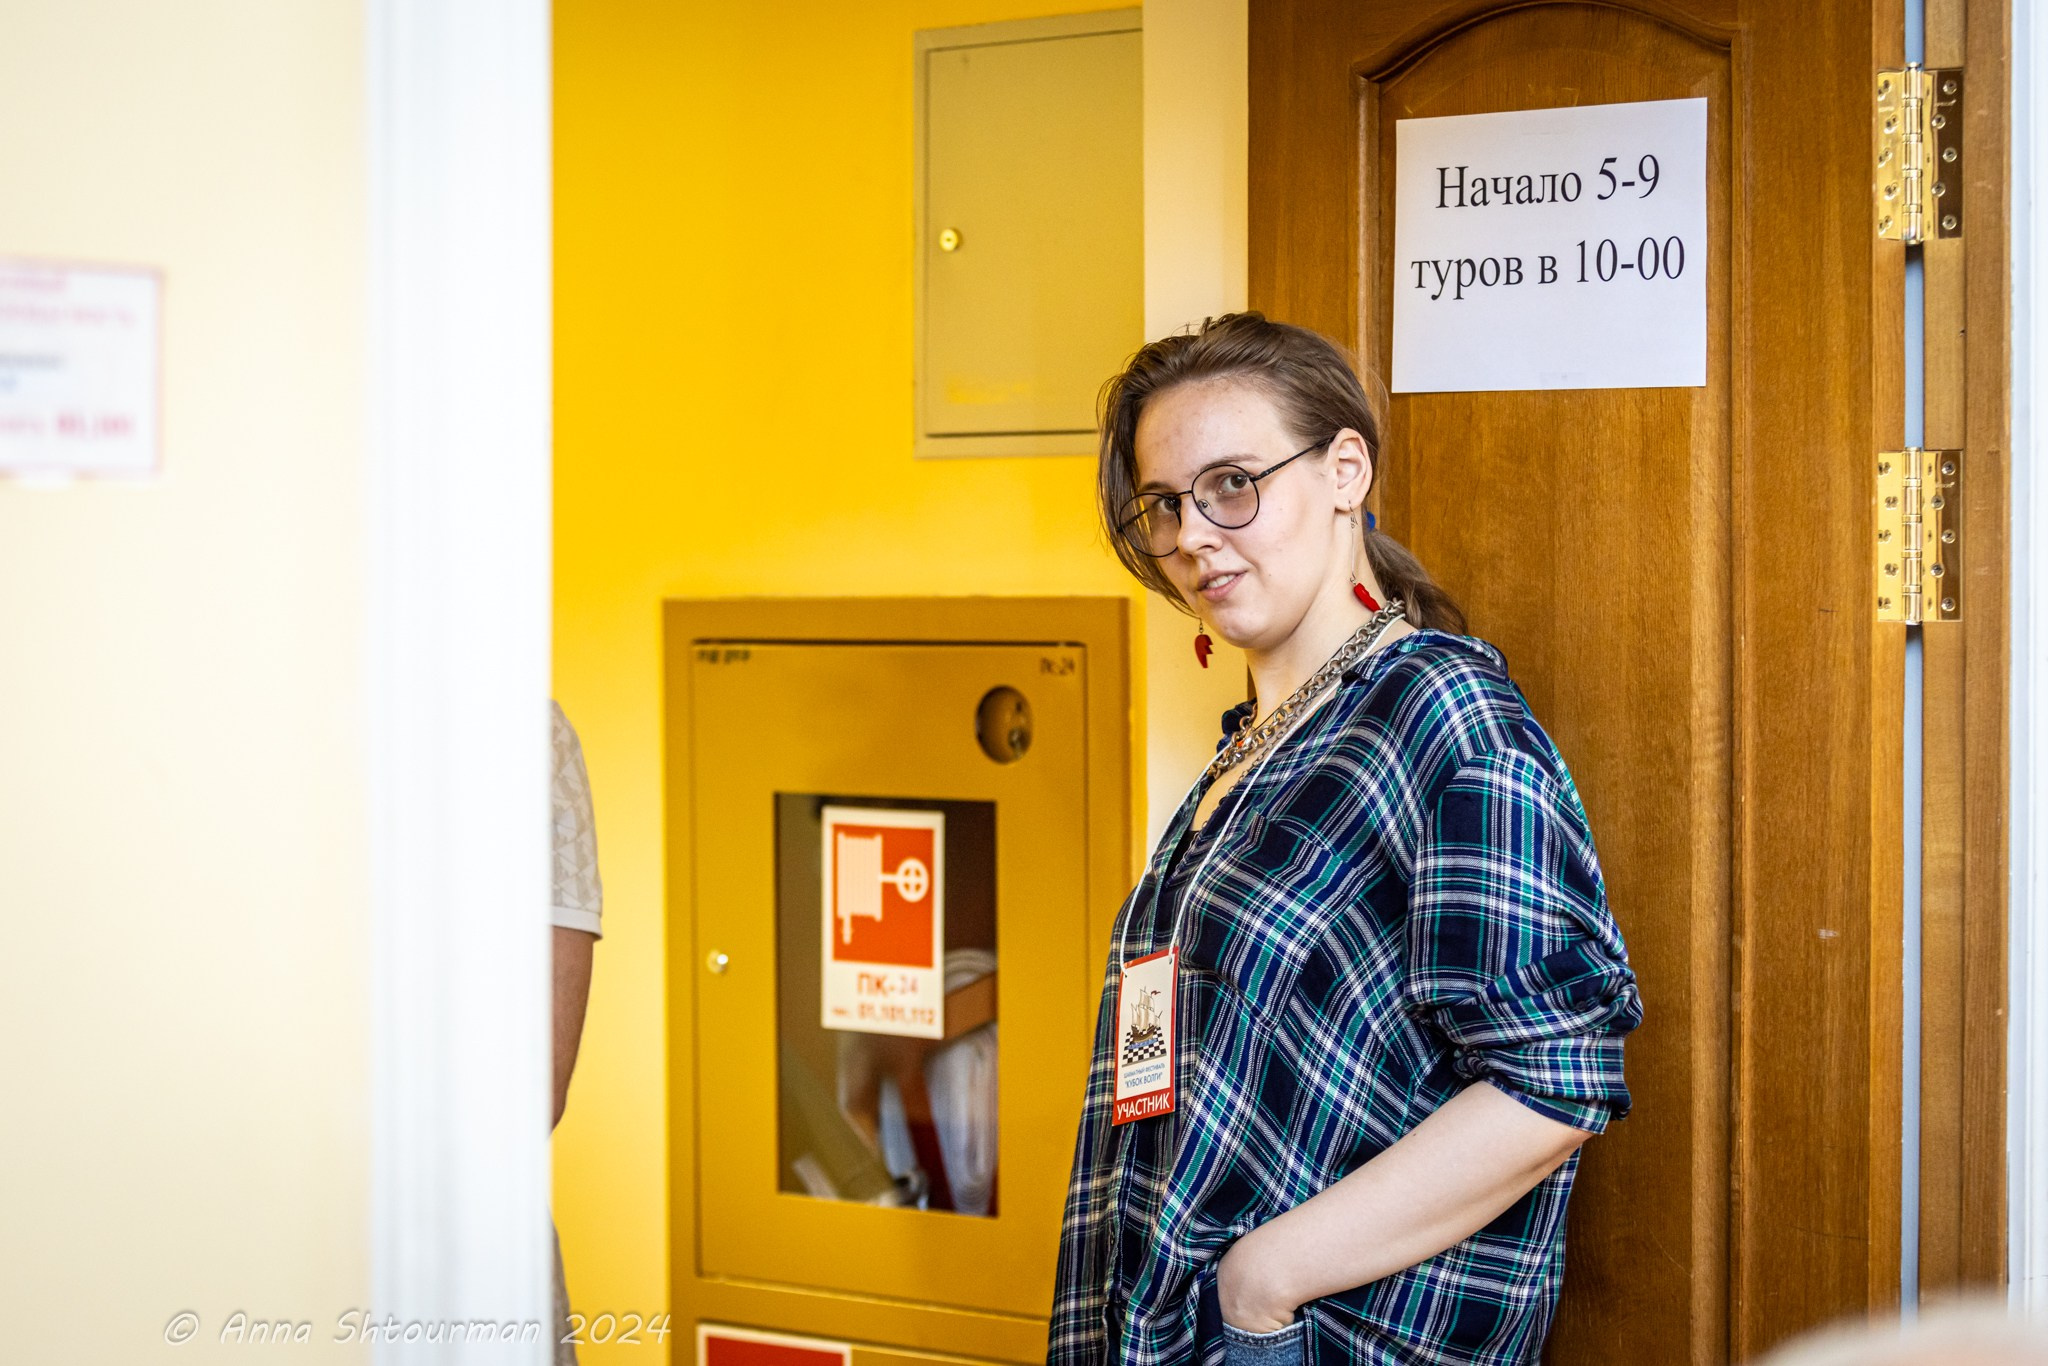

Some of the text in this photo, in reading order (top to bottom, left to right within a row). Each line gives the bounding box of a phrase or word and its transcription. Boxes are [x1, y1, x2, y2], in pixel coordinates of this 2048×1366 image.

[1435, 154, 1660, 208] Начало 5-9
[1410, 235, 1685, 301] туров в 10-00
[1117, 1092, 1170, 1120] УЧАСТНИК
